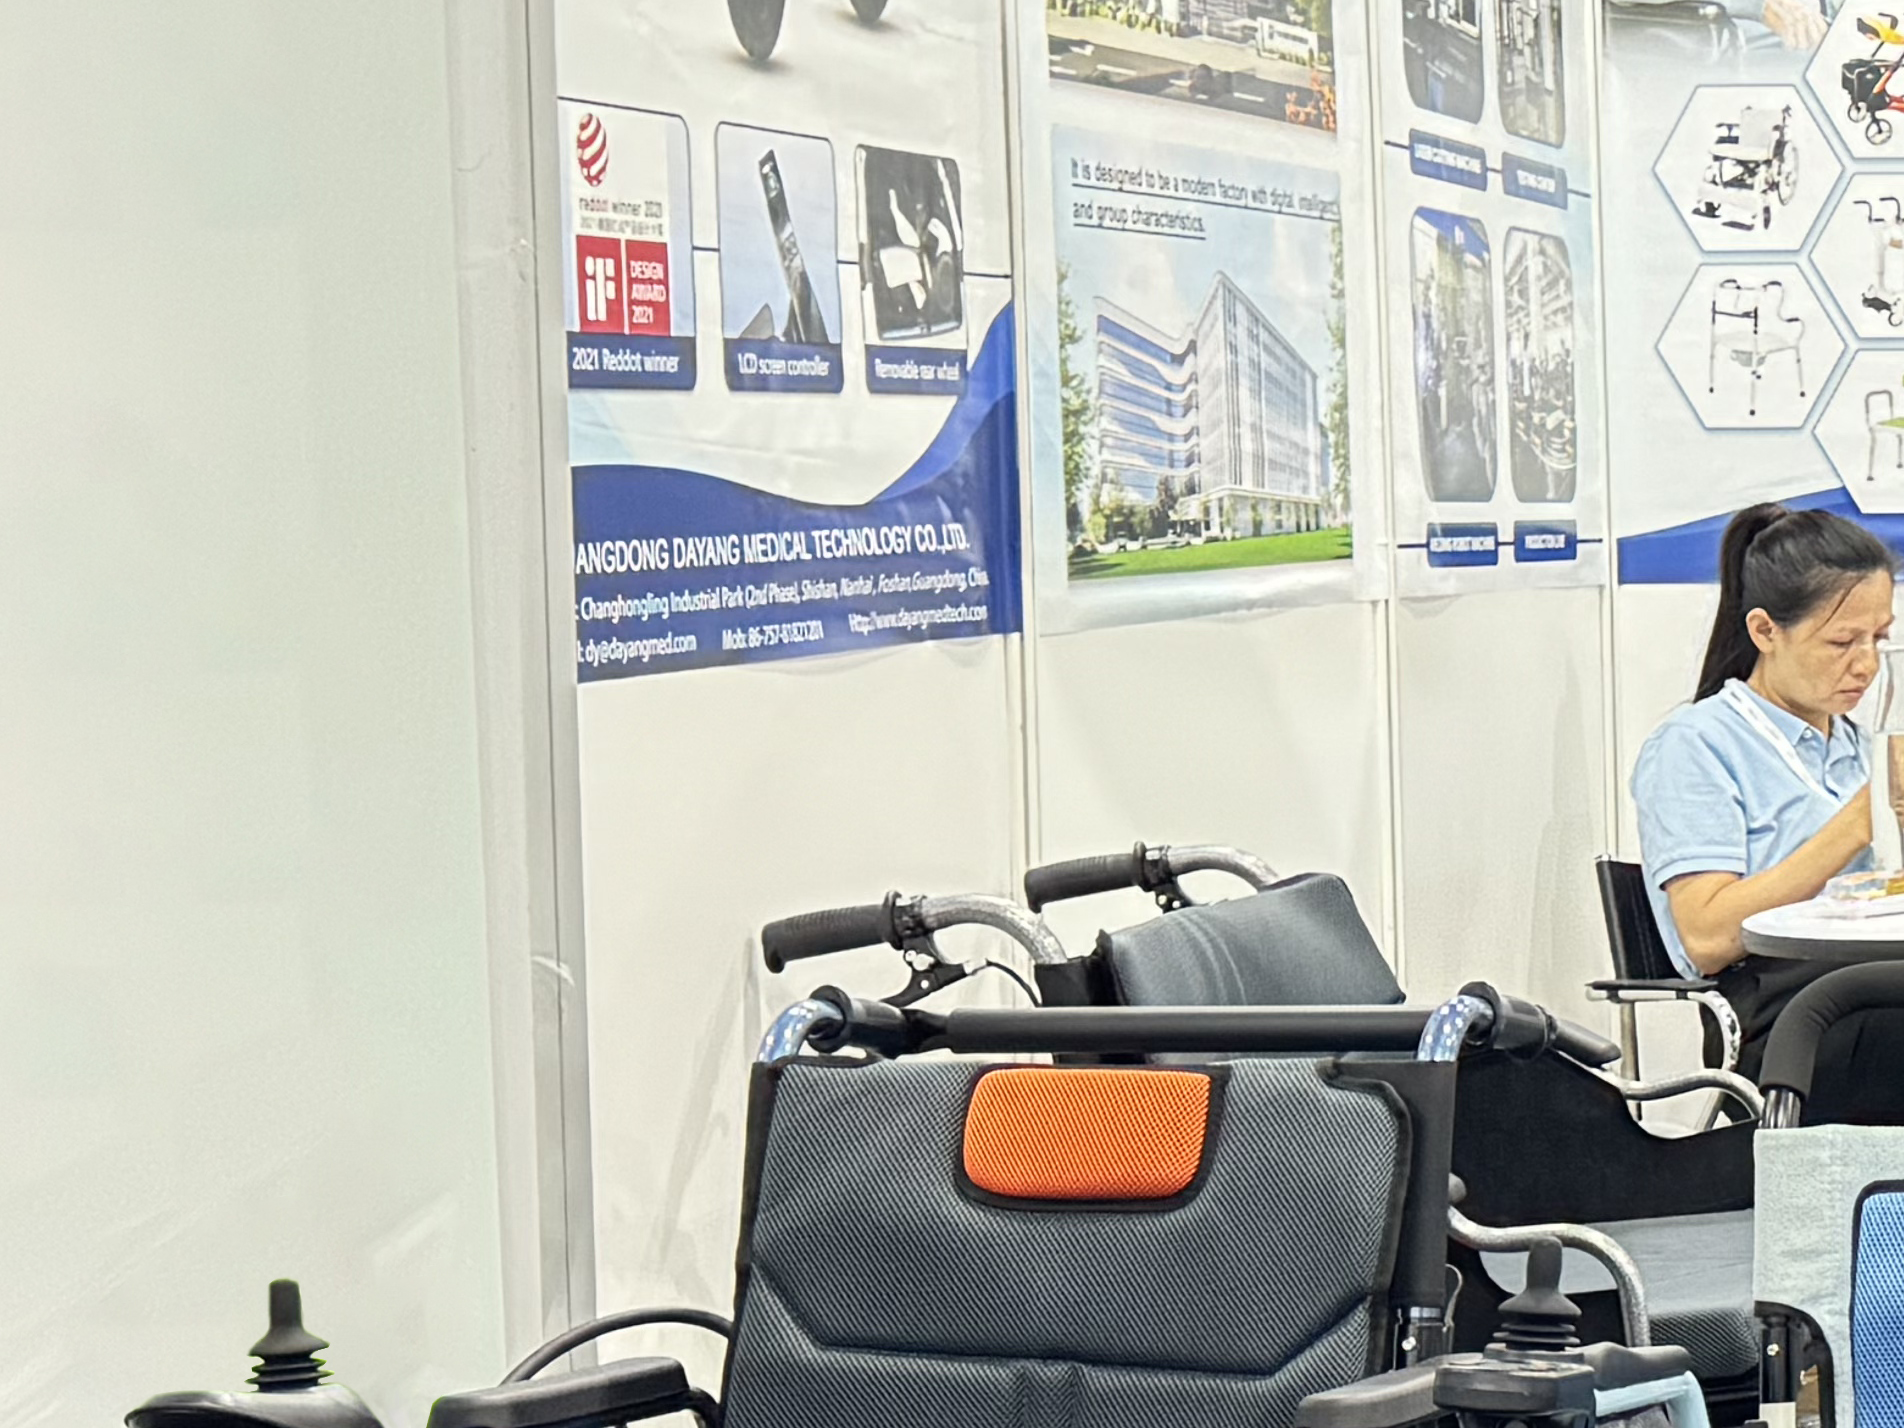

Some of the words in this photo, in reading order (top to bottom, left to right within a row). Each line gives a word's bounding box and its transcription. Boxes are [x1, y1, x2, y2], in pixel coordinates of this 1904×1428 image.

[1095, 162, 1142, 191] designed
[1145, 169, 1156, 189] to
[1158, 170, 1171, 191] be
[1073, 200, 1094, 220] and
[1096, 205, 1128, 231] group
[630, 260, 664, 280] DESIGN
[631, 284, 667, 303] AWARD
[632, 305, 654, 324] 2021
[572, 347, 600, 371] 2021
[602, 349, 643, 372] Reddot
[644, 352, 680, 373] winner
[738, 353, 757, 373] LCD
[759, 358, 785, 375] screen
[787, 356, 830, 377] controller
[674, 536, 740, 570] DAYANG
[743, 531, 812, 563] MEDICAL
[812, 527, 912, 560] TECHNOLOGY
[671, 587, 721, 613] Industrial
[722, 586, 743, 608] Park
